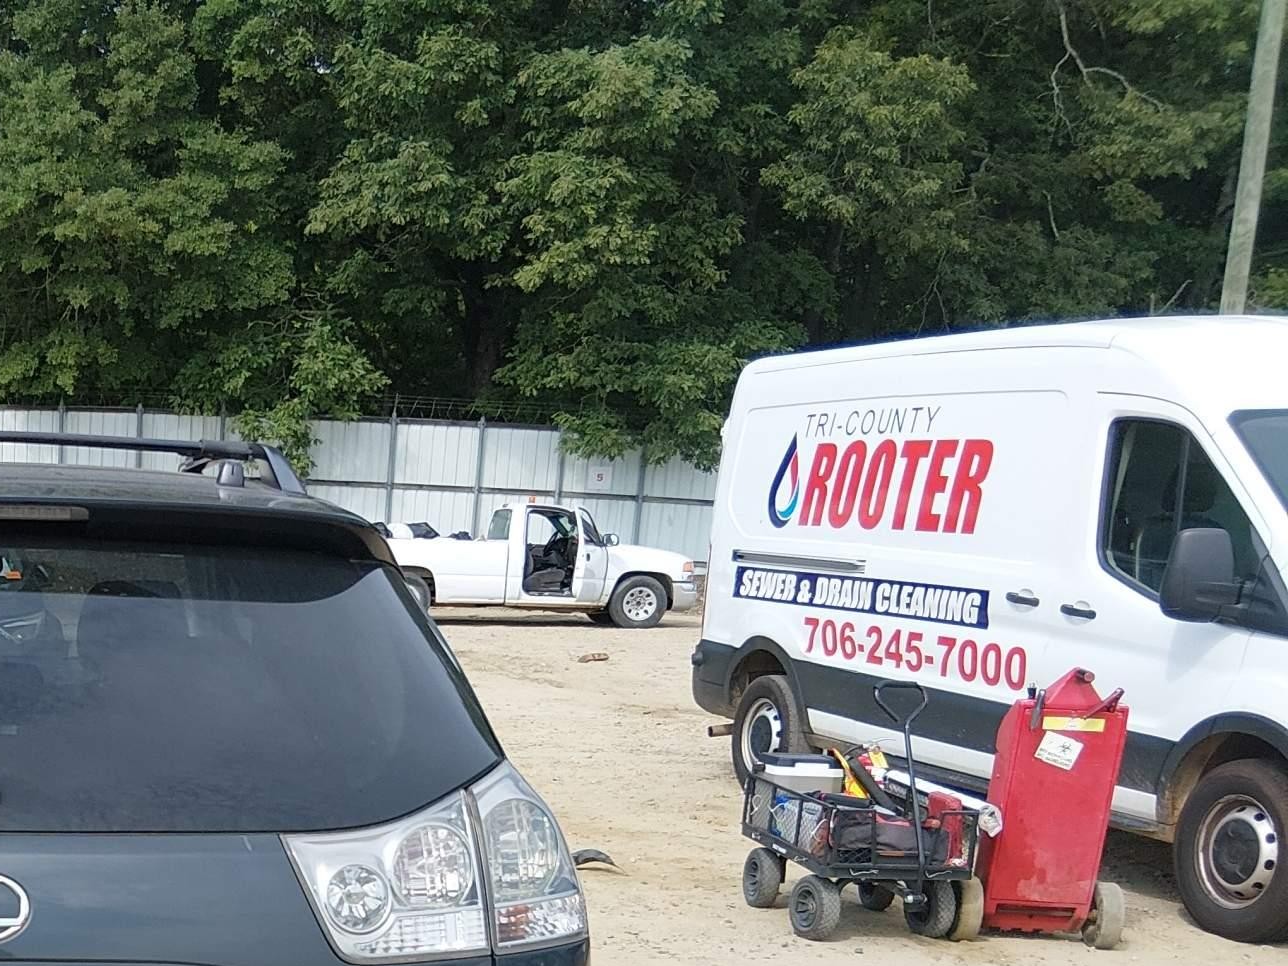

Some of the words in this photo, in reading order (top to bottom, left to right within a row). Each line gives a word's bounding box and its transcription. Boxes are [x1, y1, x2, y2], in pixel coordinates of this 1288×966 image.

[805, 406, 941, 438] TRI-COUNTY
[798, 438, 994, 535] ROOTER
[739, 569, 798, 603] SEWER
[796, 579, 812, 604] &
[813, 576, 874, 610] DRAIN
[875, 582, 982, 625] CLEANING
[803, 616, 1027, 692] 706-245-7000
